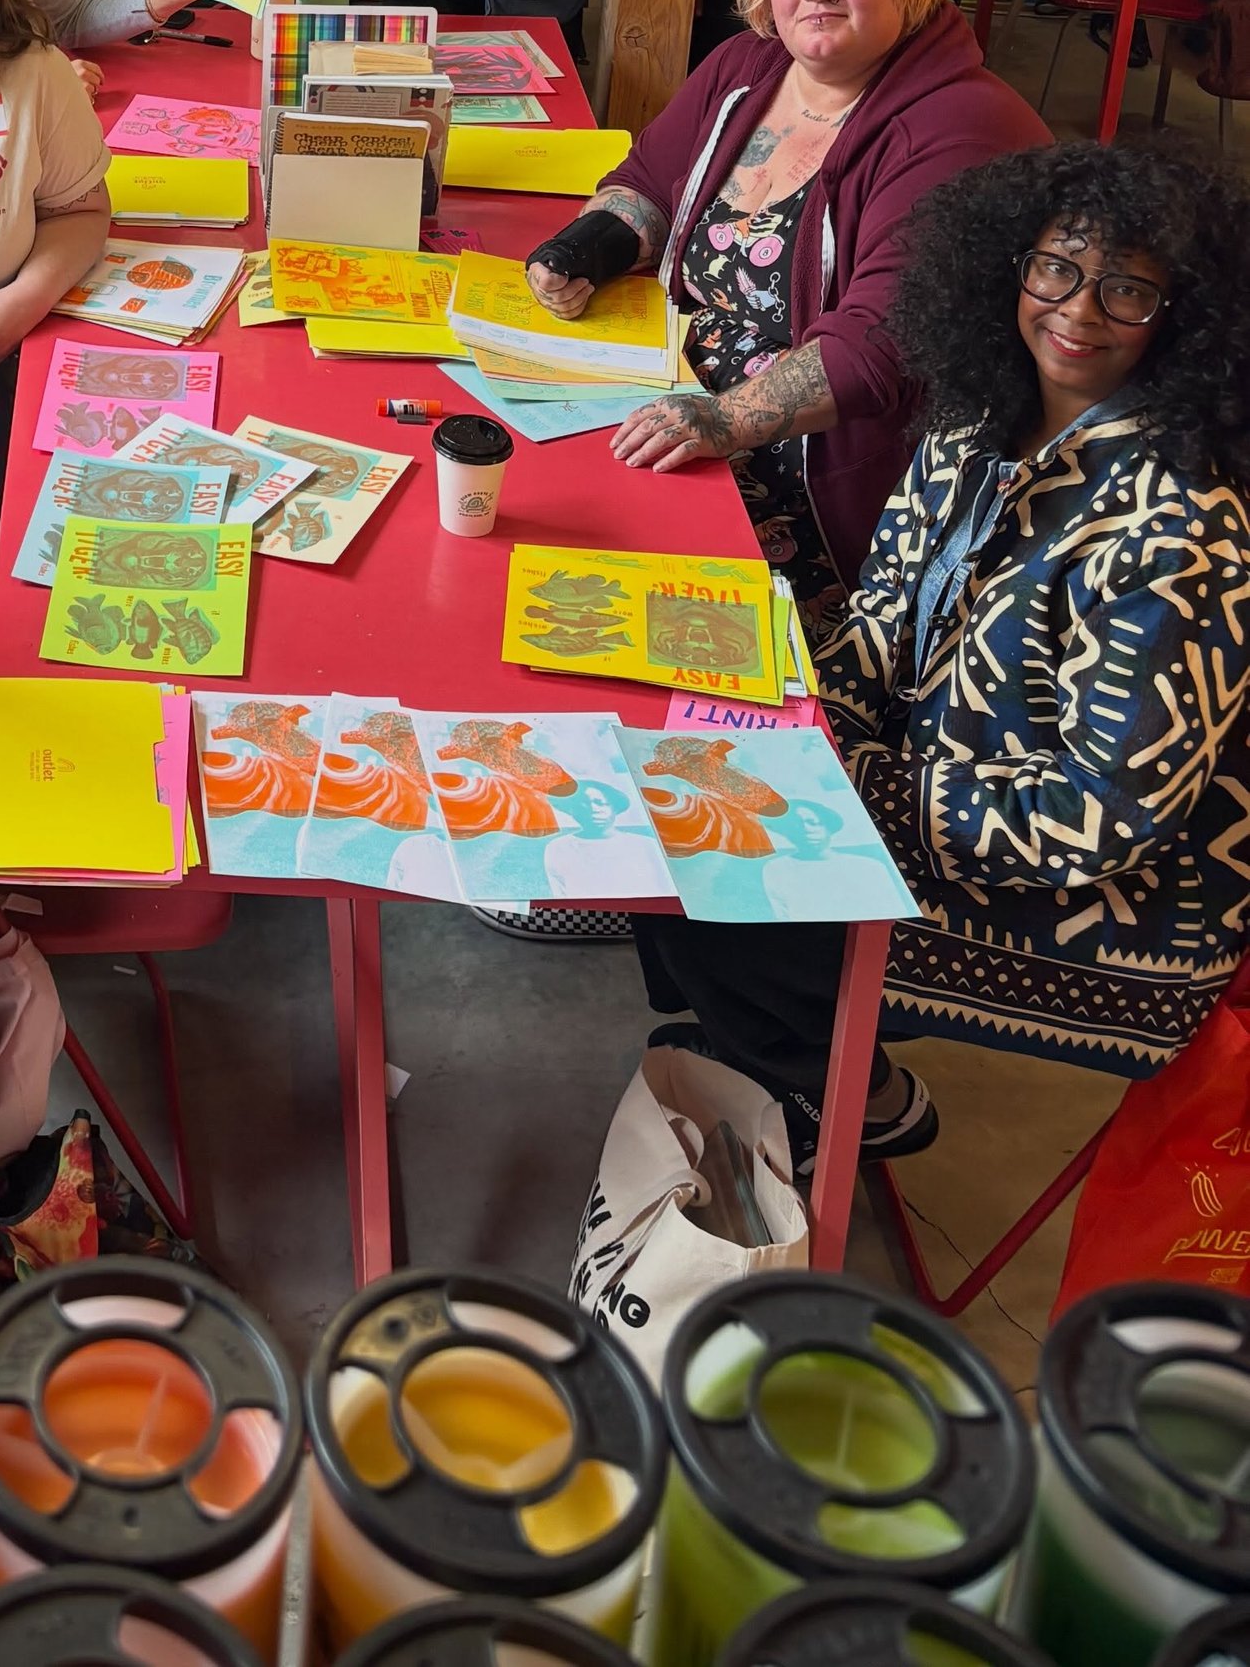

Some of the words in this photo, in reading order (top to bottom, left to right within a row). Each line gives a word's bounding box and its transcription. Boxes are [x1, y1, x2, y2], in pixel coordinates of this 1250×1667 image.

[186, 364, 212, 394] EASY
[252, 473, 297, 506] EASY
[356, 465, 399, 495] EASY
[187, 481, 223, 517] EASY
[213, 540, 246, 579] EASY
[670, 665, 741, 692] EASY
[683, 699, 790, 730] RINT!
[42, 748, 54, 782] outlet
